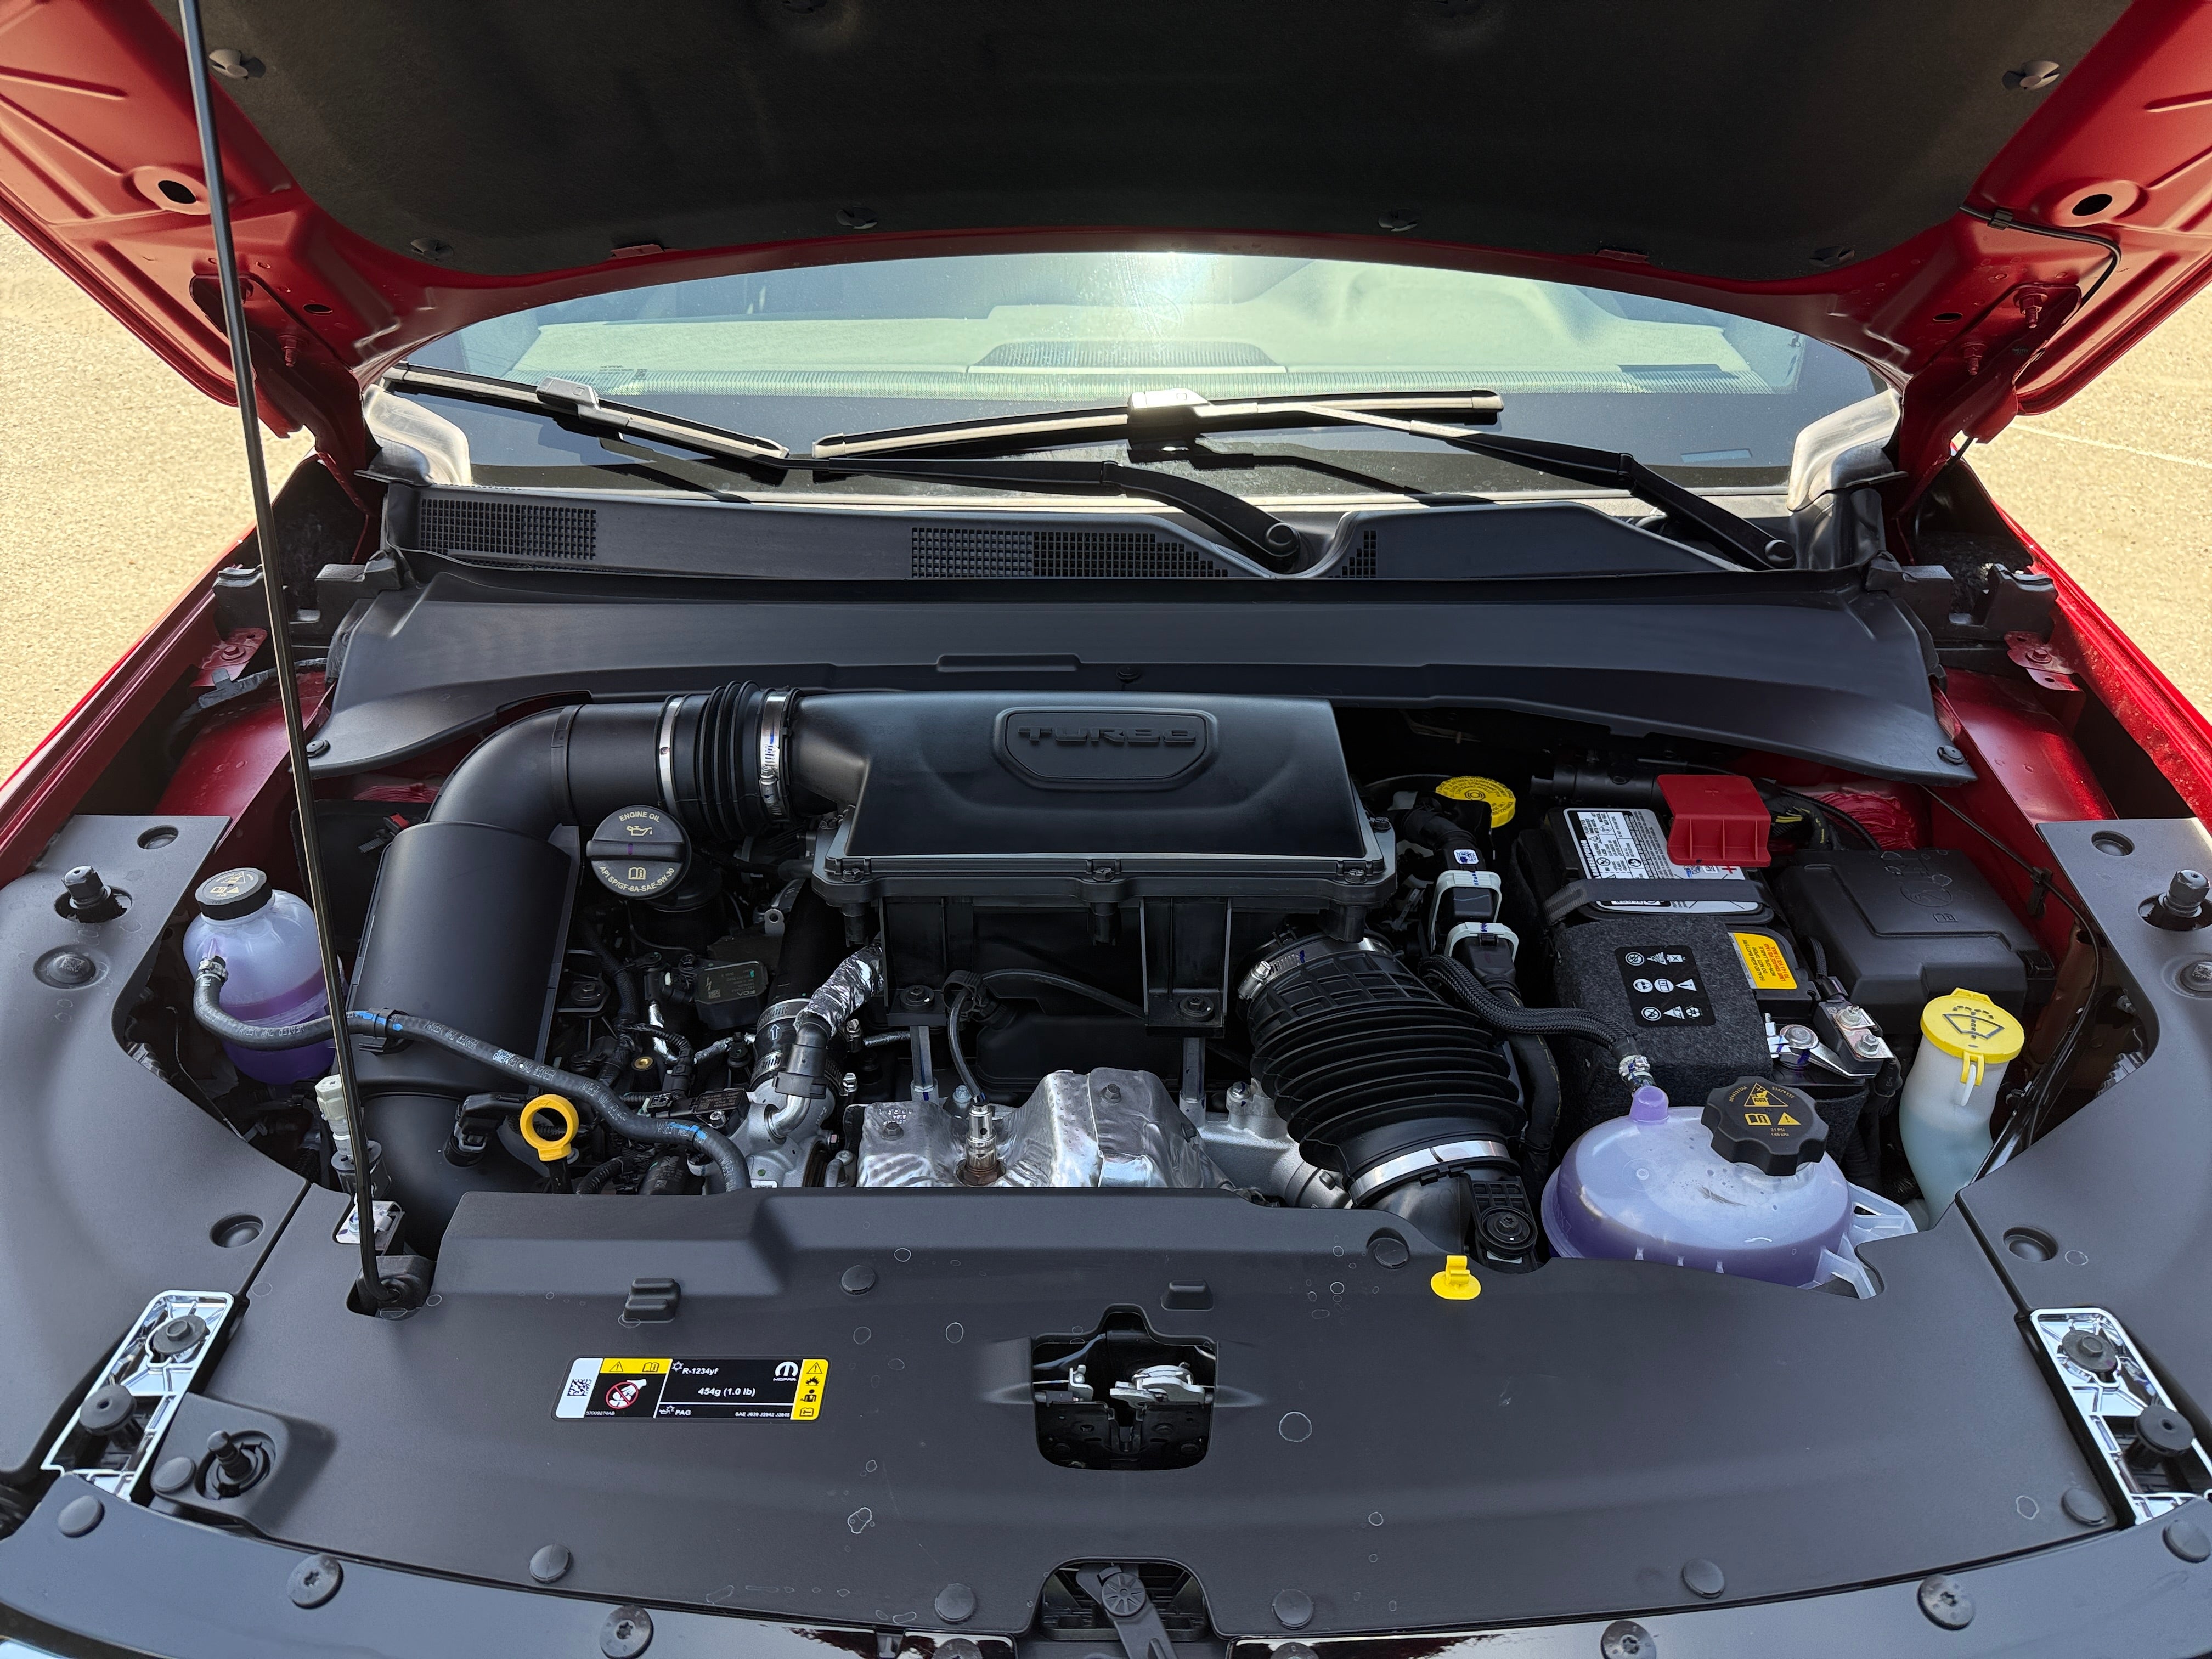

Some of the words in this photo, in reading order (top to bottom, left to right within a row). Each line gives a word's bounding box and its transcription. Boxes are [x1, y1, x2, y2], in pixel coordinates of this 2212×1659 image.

[1018, 726, 1197, 743] TURBO
[619, 811, 648, 822] ENGINE
[649, 813, 660, 823] OIL
[1581, 840, 1599, 876] DANGER/POISON
[599, 866, 610, 879] API
[1742, 939, 1753, 956] BATTERY
[1758, 946, 1776, 976] NON-SPILLABLE
[1754, 967, 1765, 981] SEALED
[682, 1367, 719, 1375] R-1234yf
[698, 1387, 721, 1397] 454g
[723, 1387, 741, 1397] (1.0
[742, 1387, 756, 1397] lb)
